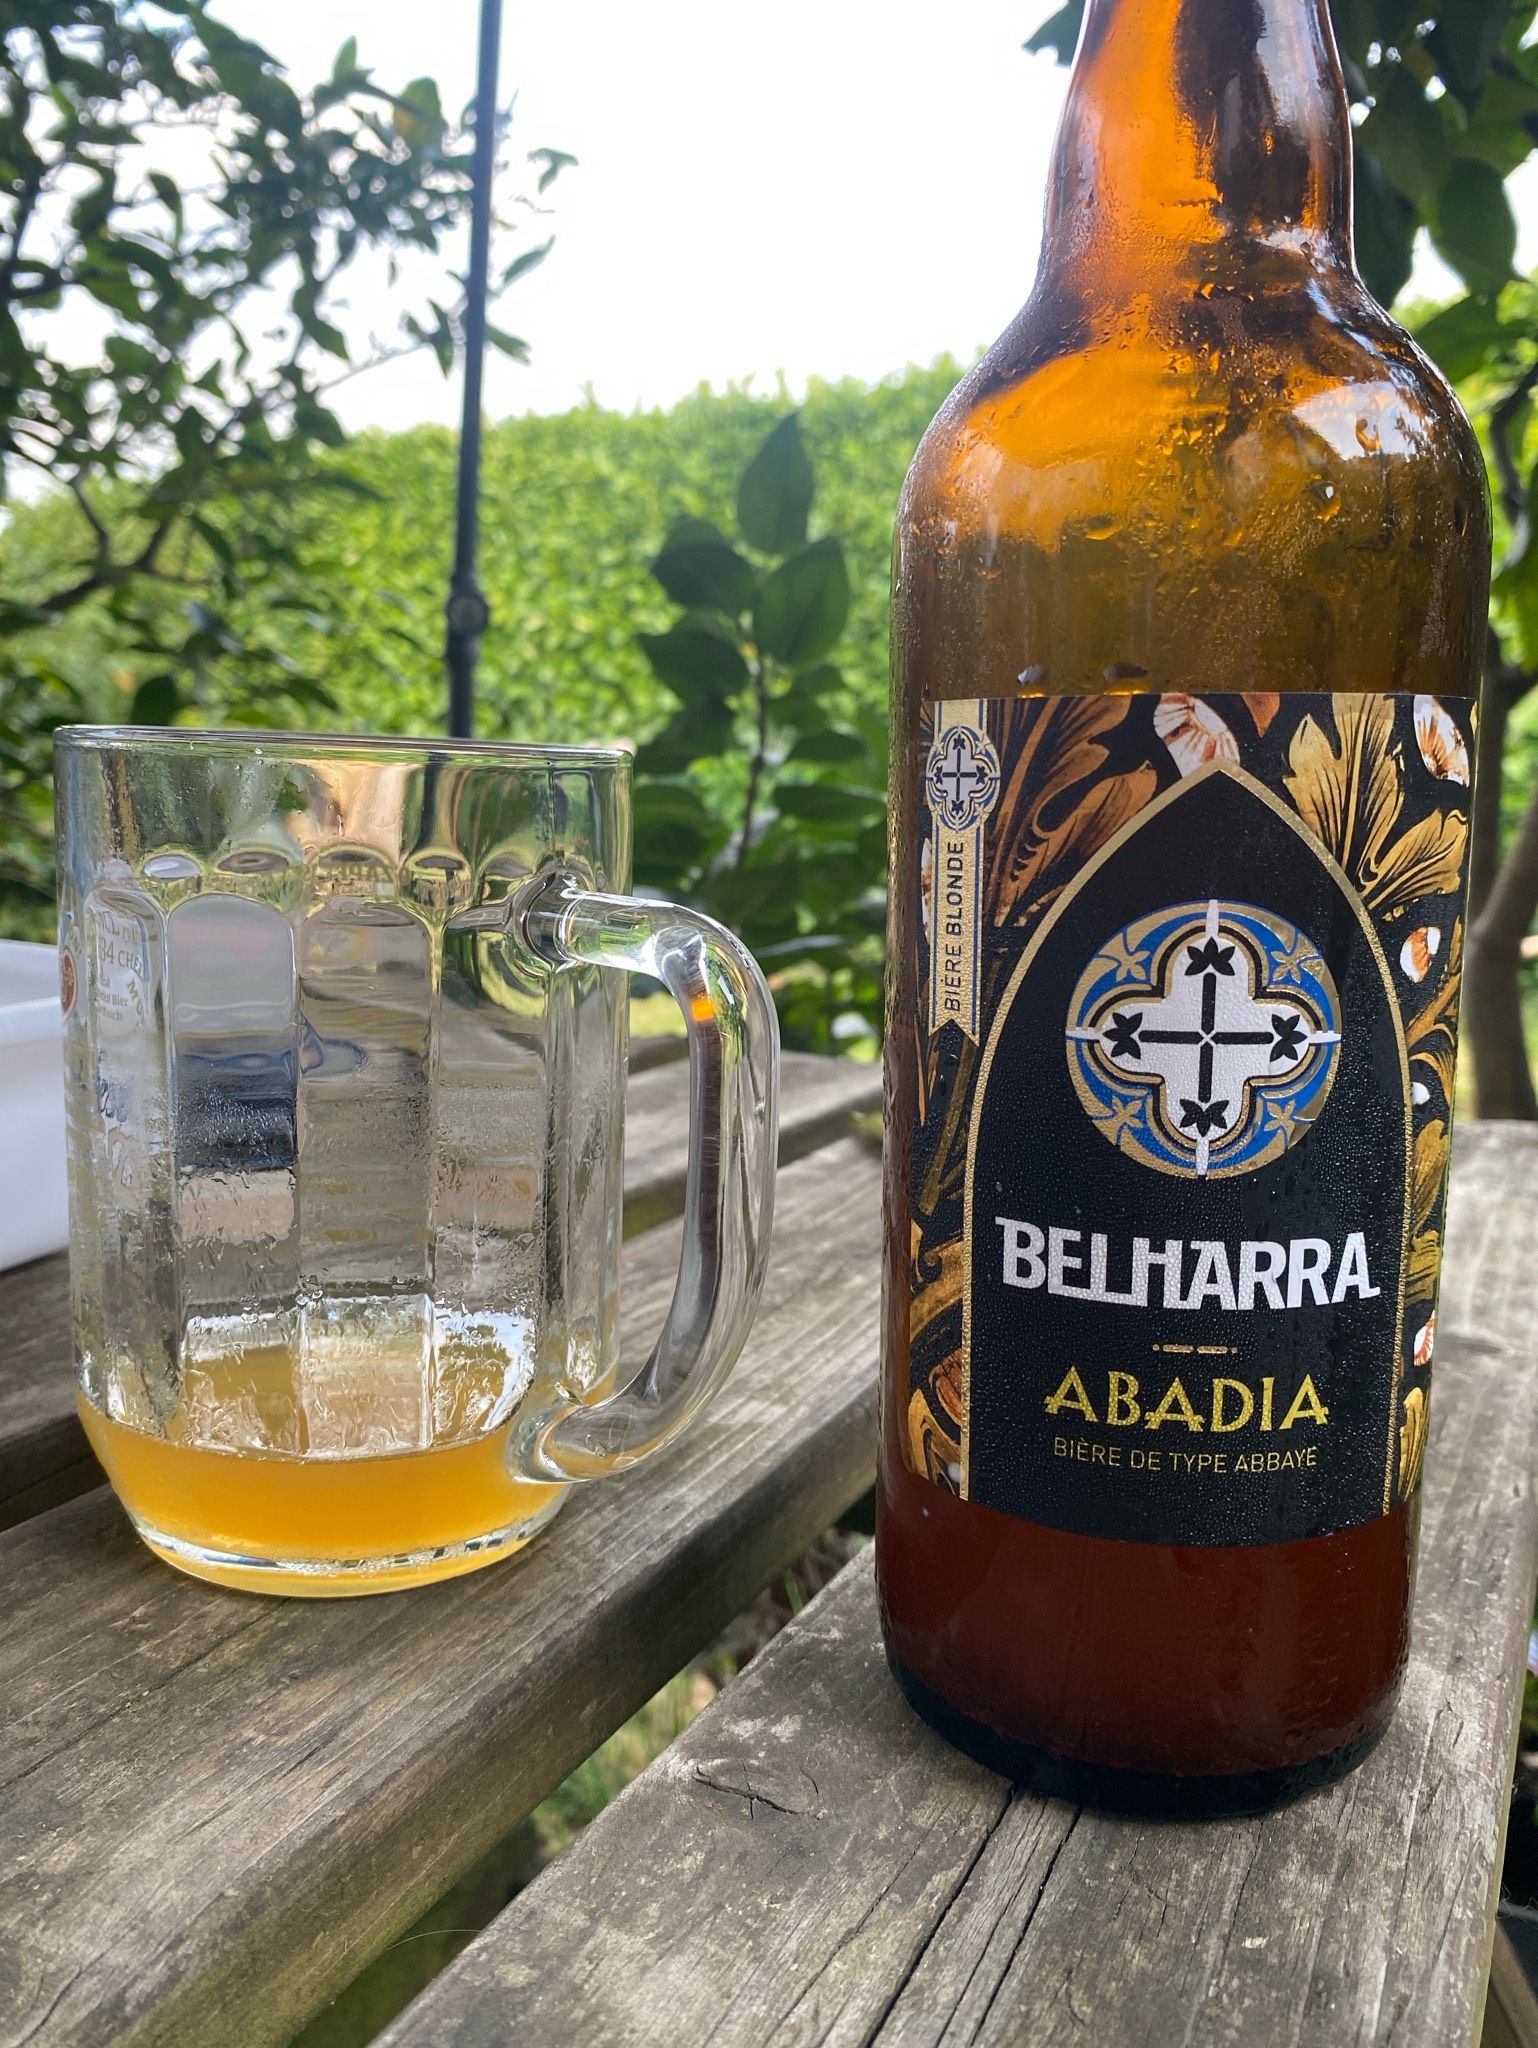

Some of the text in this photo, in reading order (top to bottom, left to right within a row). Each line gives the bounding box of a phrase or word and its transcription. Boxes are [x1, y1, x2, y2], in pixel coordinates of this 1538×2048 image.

[946, 842, 964, 936] BLONDE
[995, 1216, 1380, 1311] BELHARRA
[1044, 1364, 1330, 1432] ABADIA
[1053, 1436, 1317, 1474] BIÈRE DE TYPE ABBAYE
